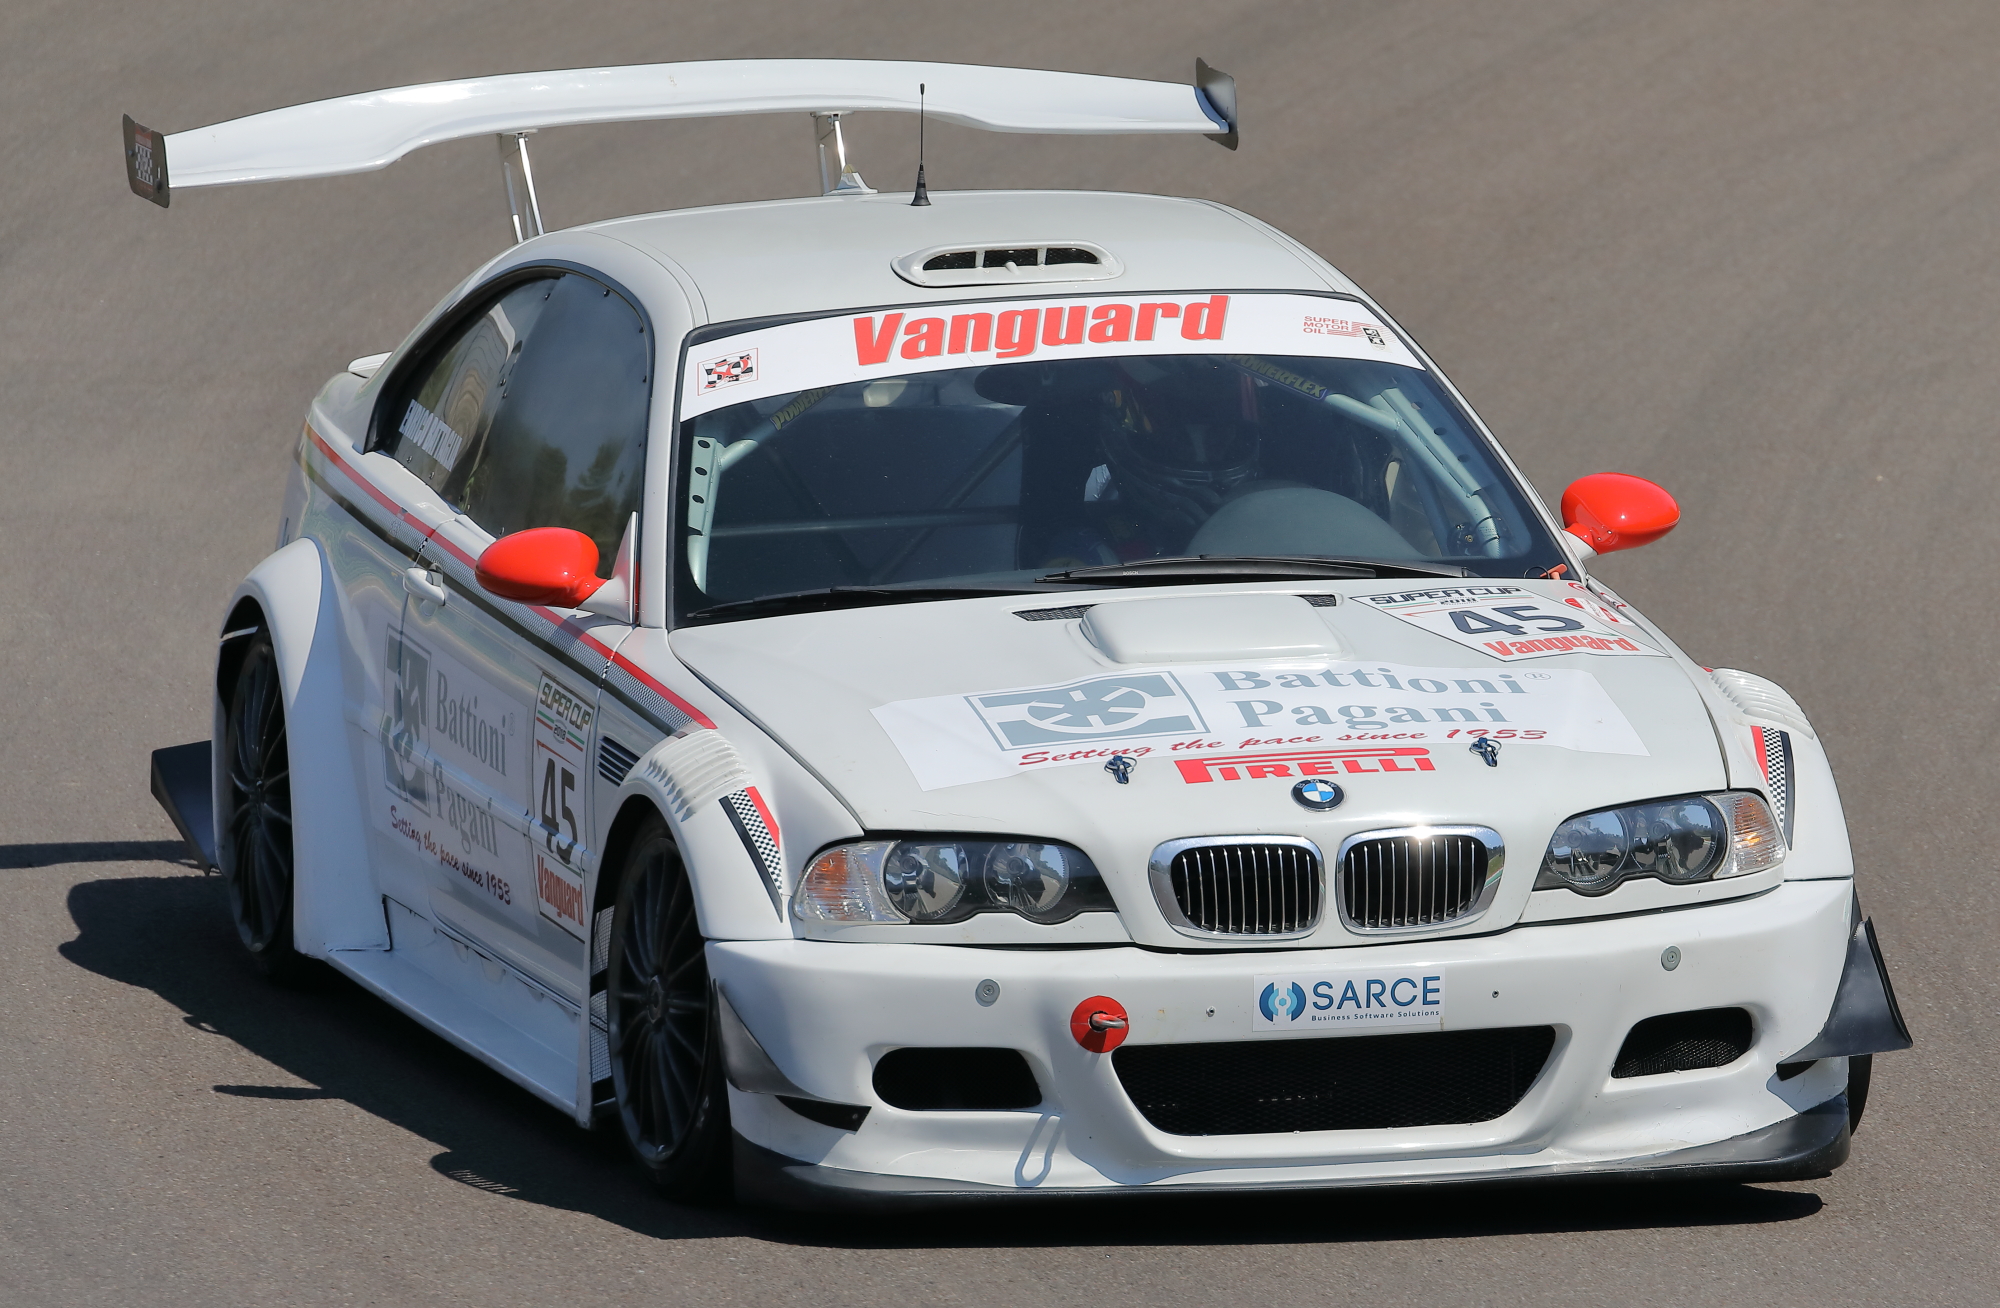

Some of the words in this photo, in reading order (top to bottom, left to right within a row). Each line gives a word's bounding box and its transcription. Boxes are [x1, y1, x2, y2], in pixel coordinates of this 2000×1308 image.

[853, 295, 1230, 366] Vanguard
[1303, 322, 1349, 331] MOTOR
[1304, 315, 1349, 325] SUPER
[1370, 588, 1464, 605] SUPER
[1465, 587, 1522, 597] CUP
[1448, 606, 1585, 637] 45
[1482, 635, 1641, 657] Vanguard
[1204, 668, 1530, 695] Battioni
[435, 669, 507, 777] Battioni
[540, 682, 573, 721] SUPER
[569, 702, 592, 732] CUP
[1226, 700, 1513, 730] Pagani
[1018, 744, 1156, 767] Setting
[1169, 738, 1225, 751] the
[1239, 734, 1324, 749] pace
[1336, 732, 1428, 741] since
[1446, 729, 1548, 741] 1953
[1174, 747, 1436, 784] PIRELLI
[433, 758, 499, 858] Pagani
[541, 758, 578, 865] 45
[390, 805, 421, 852] Setting
[424, 830, 437, 856] the
[440, 844, 460, 871] pace
[462, 862, 484, 887] since
[486, 871, 511, 905] 1953
[537, 854, 584, 927] Vanguard
[1312, 976, 1440, 1010] SARCE
[1398, 1010, 1439, 1018] Solutions
